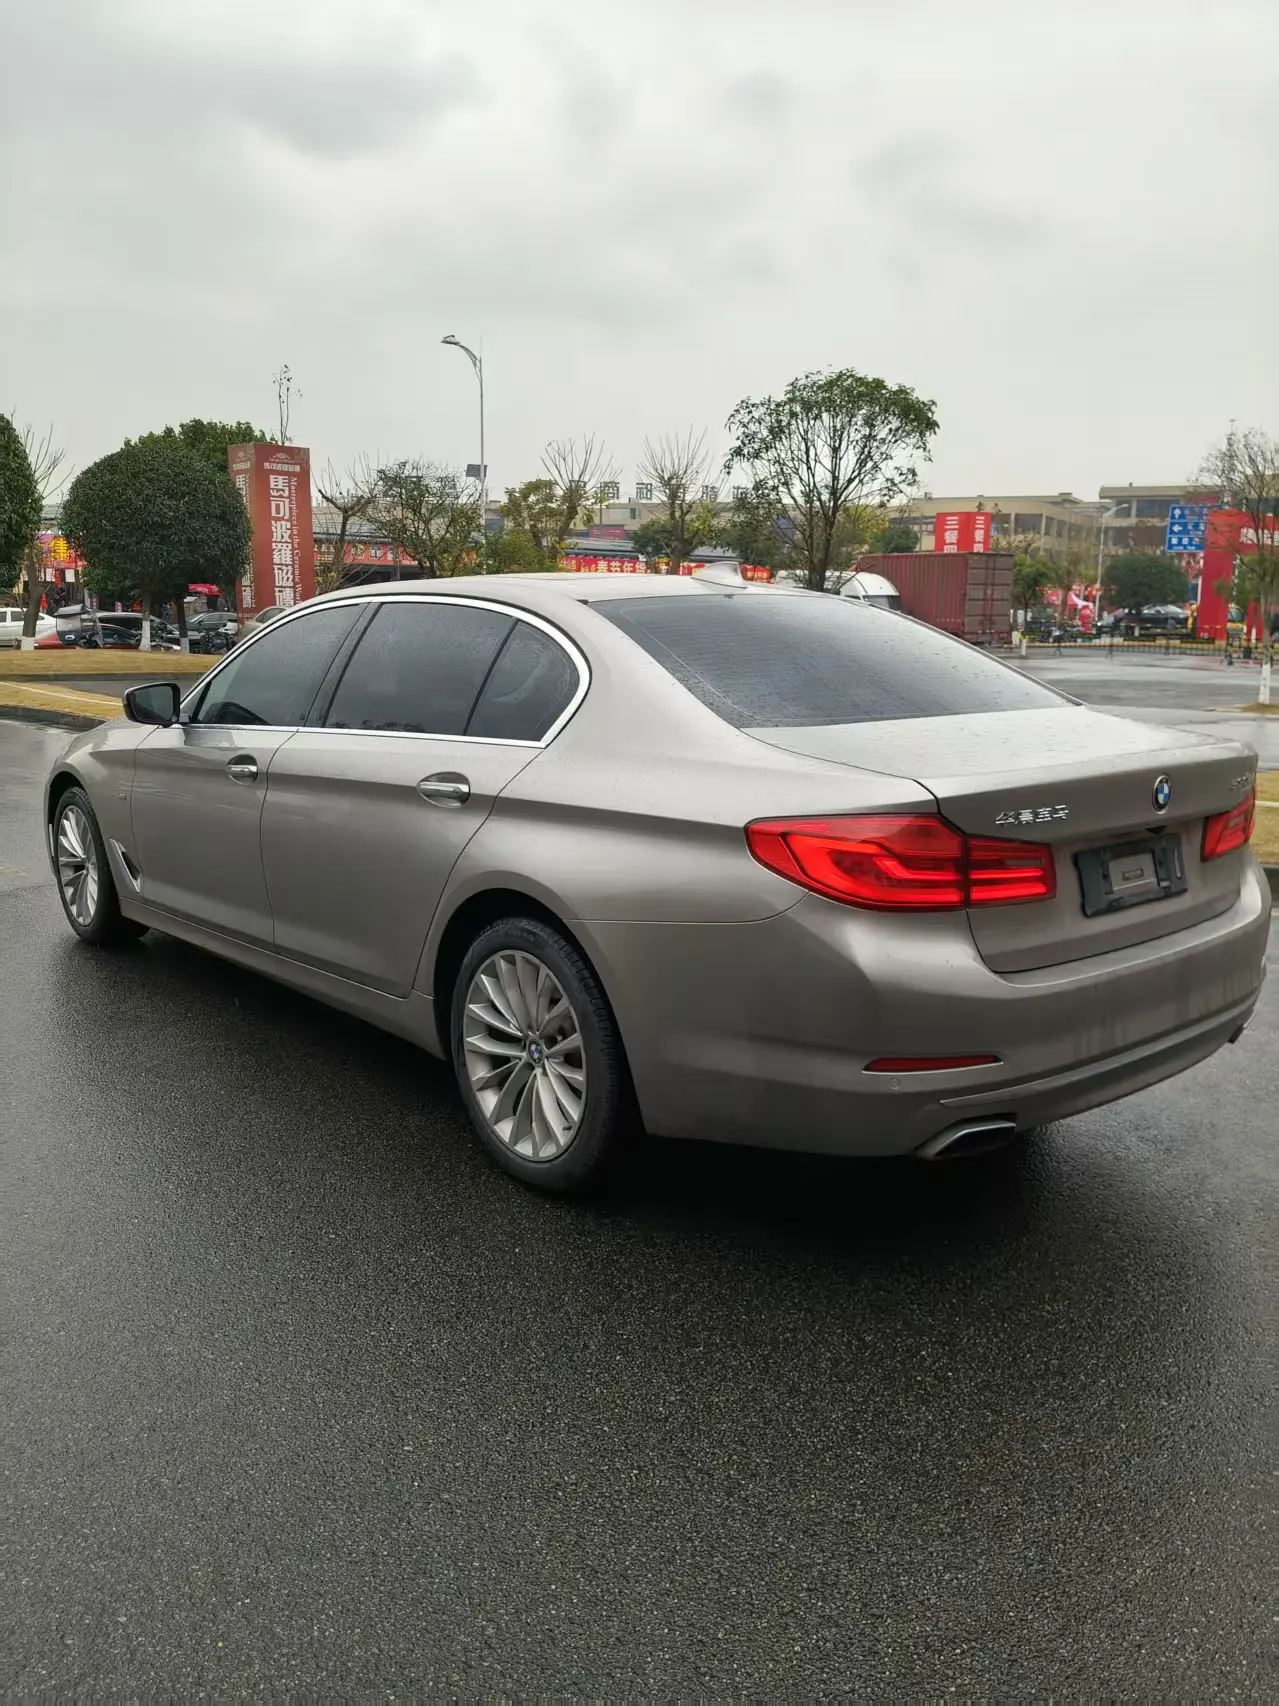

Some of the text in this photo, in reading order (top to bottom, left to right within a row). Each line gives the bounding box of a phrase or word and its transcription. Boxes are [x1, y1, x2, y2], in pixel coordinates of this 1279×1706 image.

[290, 476, 298, 525] Masterpiece
[269, 474, 295, 607] 馬可波羅磁磚
[293, 549, 301, 583] Ceramic
[295, 584, 303, 605] Worl
[995, 804, 1070, 825] 华晨宝马
